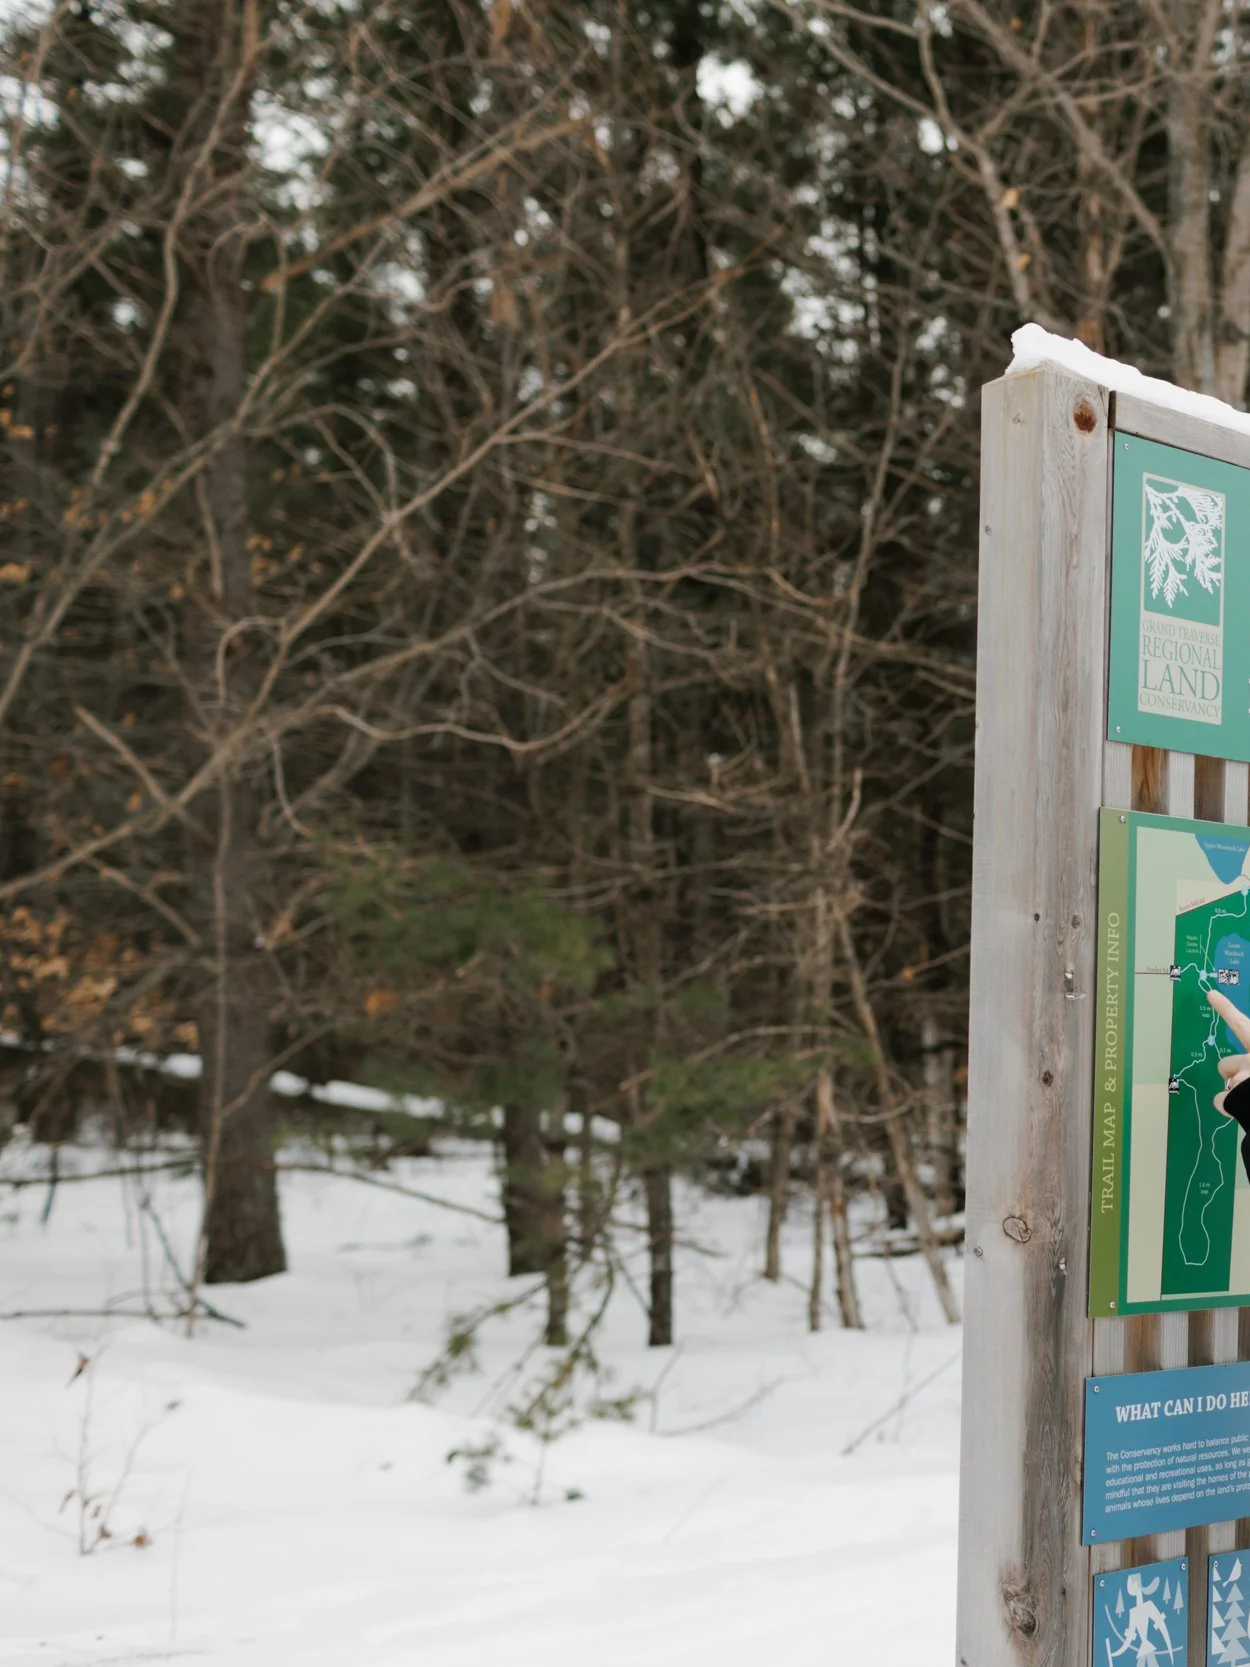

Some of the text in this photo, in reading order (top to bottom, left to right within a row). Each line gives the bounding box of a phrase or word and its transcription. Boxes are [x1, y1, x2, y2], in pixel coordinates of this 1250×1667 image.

[1142, 619, 1220, 647] GRAND TRAVERSE
[1142, 634, 1220, 670] REGIONAL
[1142, 658, 1220, 701] LAND
[1140, 692, 1220, 718] CONSERVANCY
[1102, 912, 1120, 1214] TRAIL MAP & PROPERTY INFO
[1116, 1402, 1160, 1422] WHAT
[1164, 1398, 1193, 1416] CAN
[1198, 1397, 1202, 1412] I
[1206, 1394, 1226, 1411] DO
[1106, 1465, 1120, 1473] with
[1121, 1463, 1132, 1472] the
[1134, 1459, 1166, 1471] protection
[1168, 1456, 1174, 1465] of
[1176, 1454, 1197, 1463] natural
[1232, 1447, 1241, 1455] We
[1107, 1452, 1118, 1460] The
[1120, 1448, 1161, 1459] Conservancy
[1163, 1444, 1181, 1453] works
[1183, 1441, 1197, 1450] hard
[1206, 1438, 1230, 1446] balance
[1231, 1434, 1249, 1444] public
[1106, 1475, 1144, 1486] educational
[1145, 1472, 1158, 1481] and
[1159, 1467, 1196, 1478] recreational
[1224, 1460, 1237, 1469] long
[1238, 1459, 1246, 1467] as
[1106, 1488, 1130, 1499] mindful
[1132, 1487, 1144, 1495] that
[1146, 1485, 1160, 1493] they
[1161, 1483, 1172, 1491] are
[1174, 1479, 1195, 1488] visiting
[1197, 1477, 1206, 1485] the
[1208, 1475, 1229, 1483] homes
[1230, 1471, 1236, 1480] of
[1105, 1502, 1131, 1512] animals
[1133, 1499, 1154, 1508] whose
[1155, 1496, 1170, 1504] lives
[1172, 1491, 1195, 1502] depend
[1206, 1488, 1216, 1496] the
